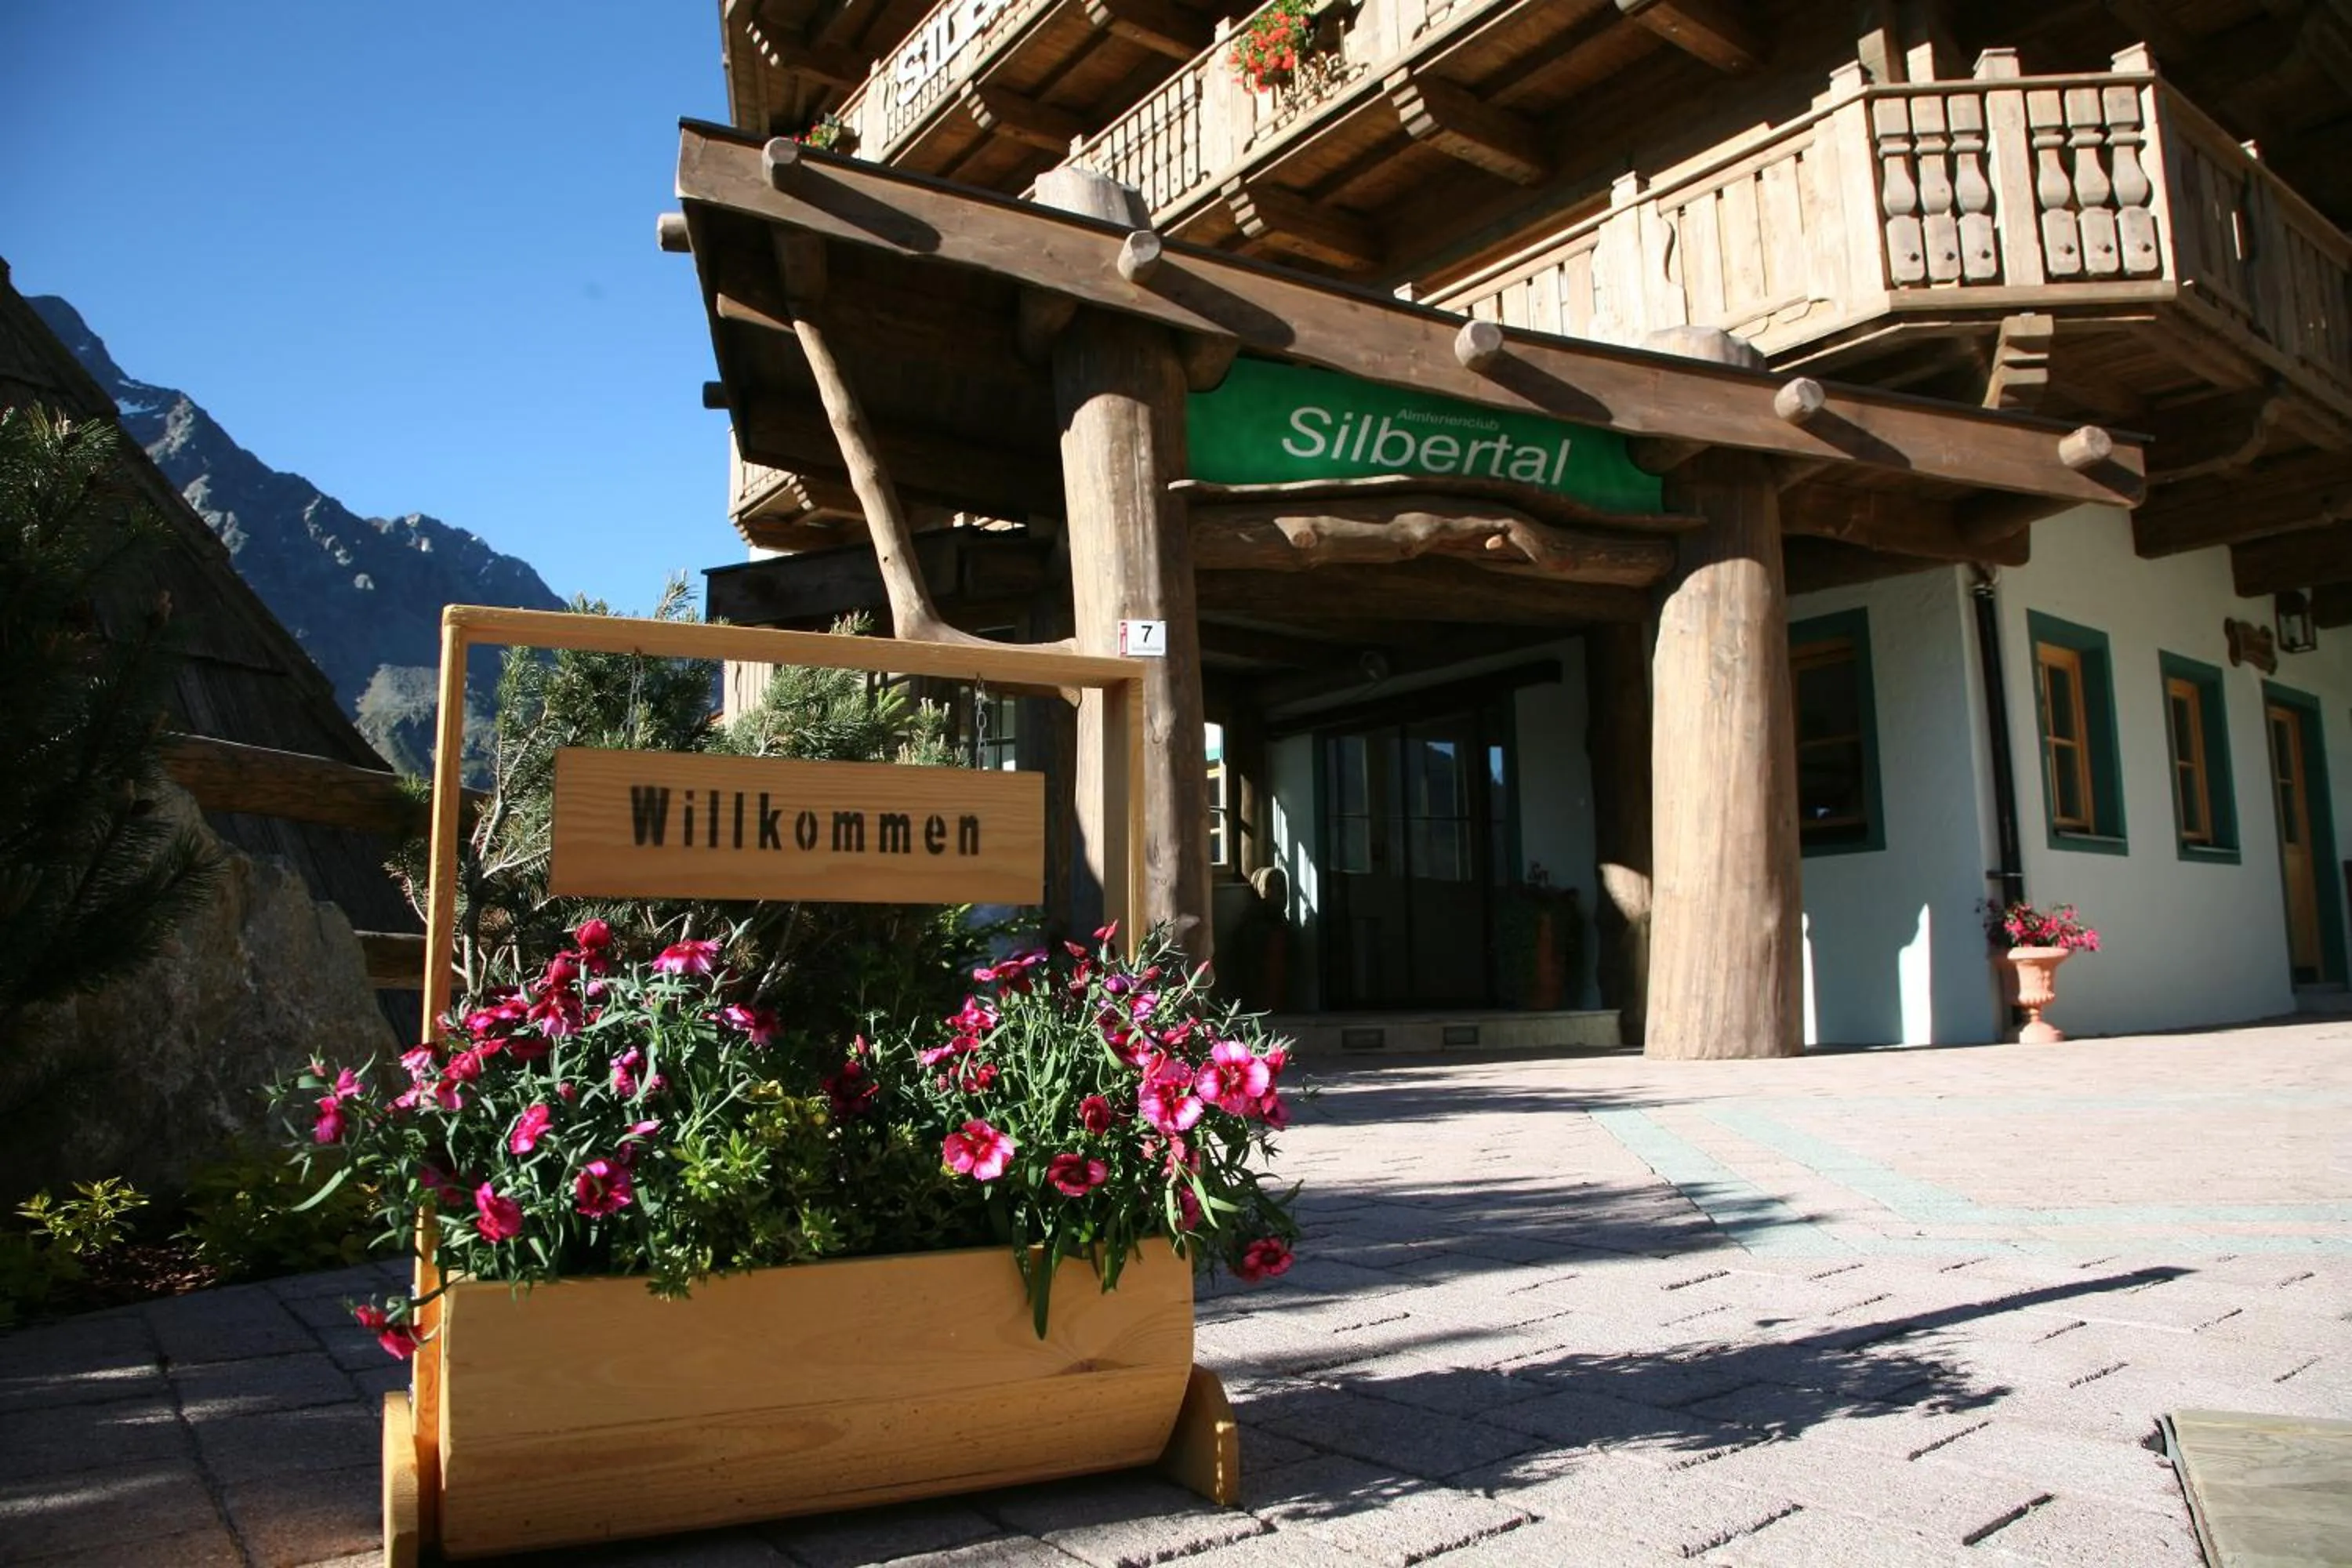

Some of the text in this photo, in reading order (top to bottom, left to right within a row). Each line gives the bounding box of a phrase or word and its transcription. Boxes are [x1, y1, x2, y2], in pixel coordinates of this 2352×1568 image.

[1281, 406, 1571, 486] Silbertal
[1141, 625, 1153, 644] 7
[630, 785, 980, 855] Willkommen
